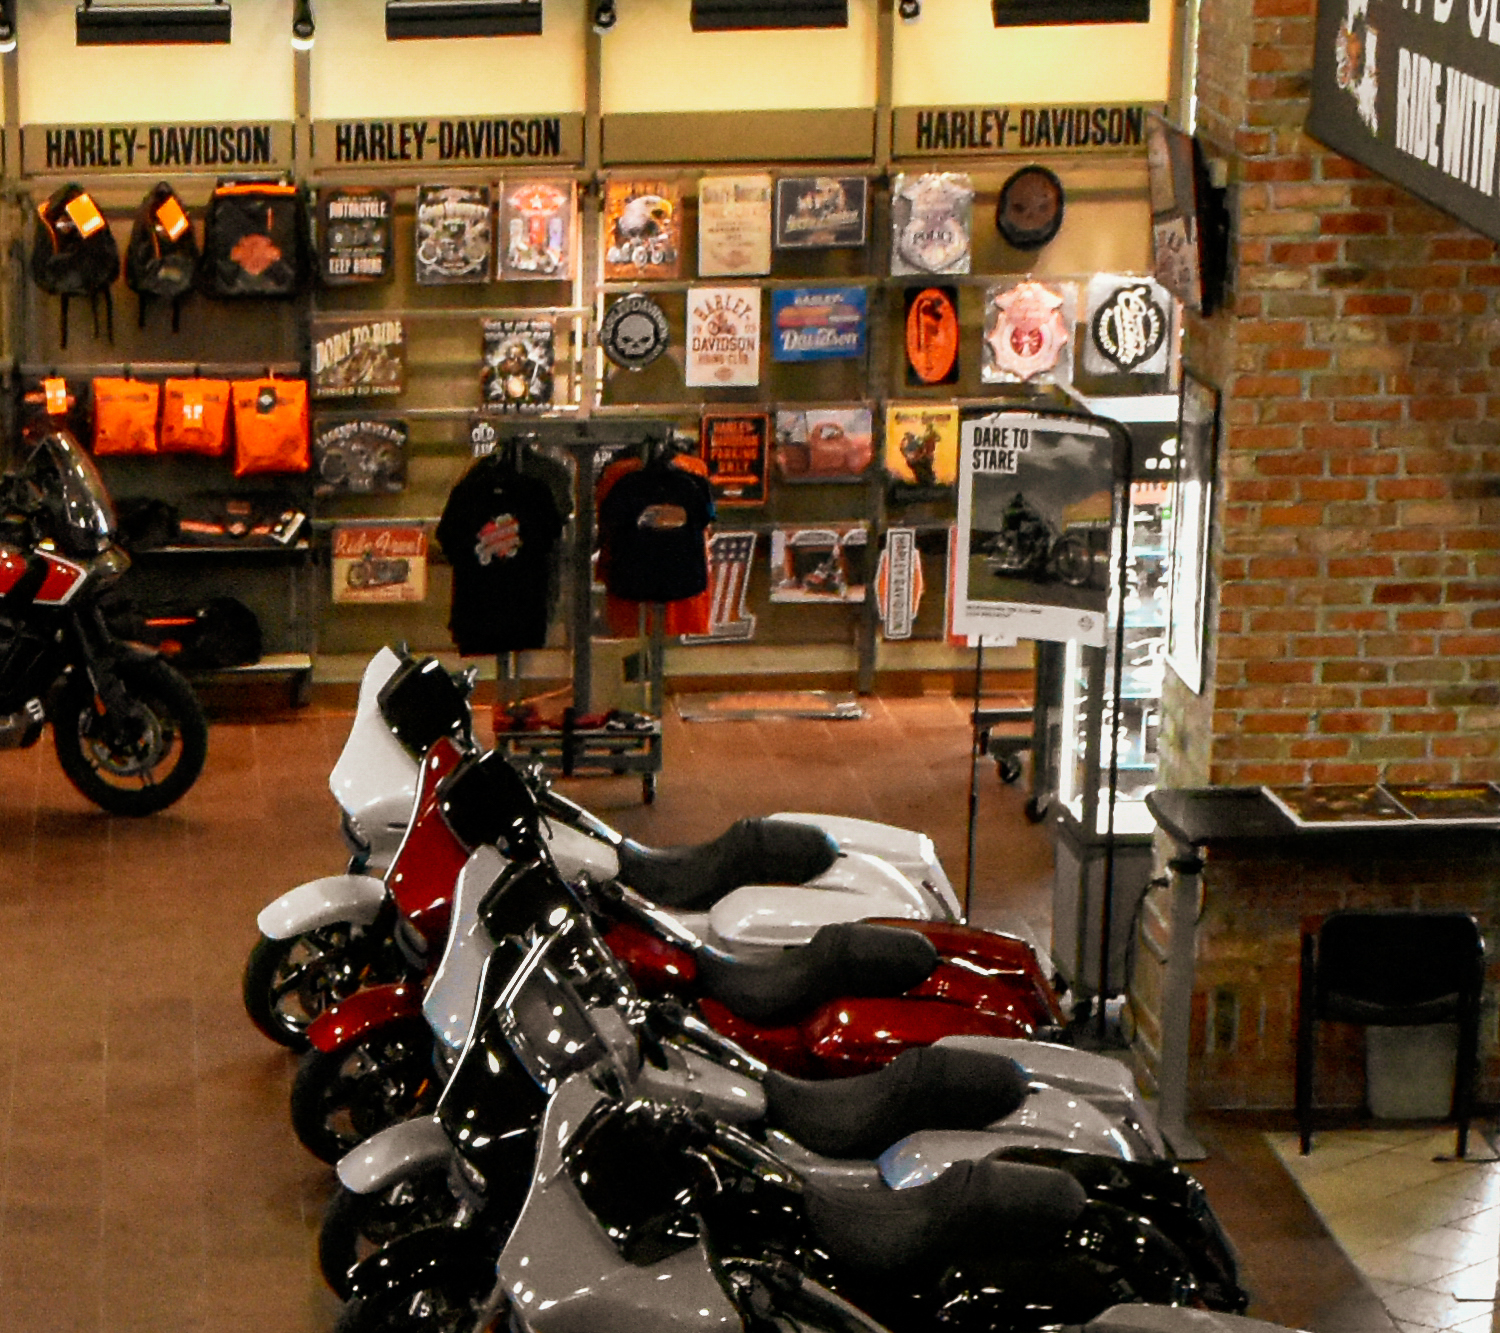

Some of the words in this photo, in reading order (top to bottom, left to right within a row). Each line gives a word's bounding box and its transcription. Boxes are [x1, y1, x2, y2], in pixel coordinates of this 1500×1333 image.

[917, 106, 1144, 149] HARLEY-DAVIDSON
[1396, 48, 1442, 167] RIDE
[1442, 66, 1500, 197] WITH
[47, 126, 272, 167] HARLEY-DAVIDSON
[336, 117, 561, 162] HARLEY-DAVIDSON
[691, 335, 756, 352] DAVIDSON
[780, 326, 860, 351] Davidson
[973, 426, 1009, 448] DARE
[1011, 427, 1029, 449] TO
[972, 449, 1016, 472] STARE
